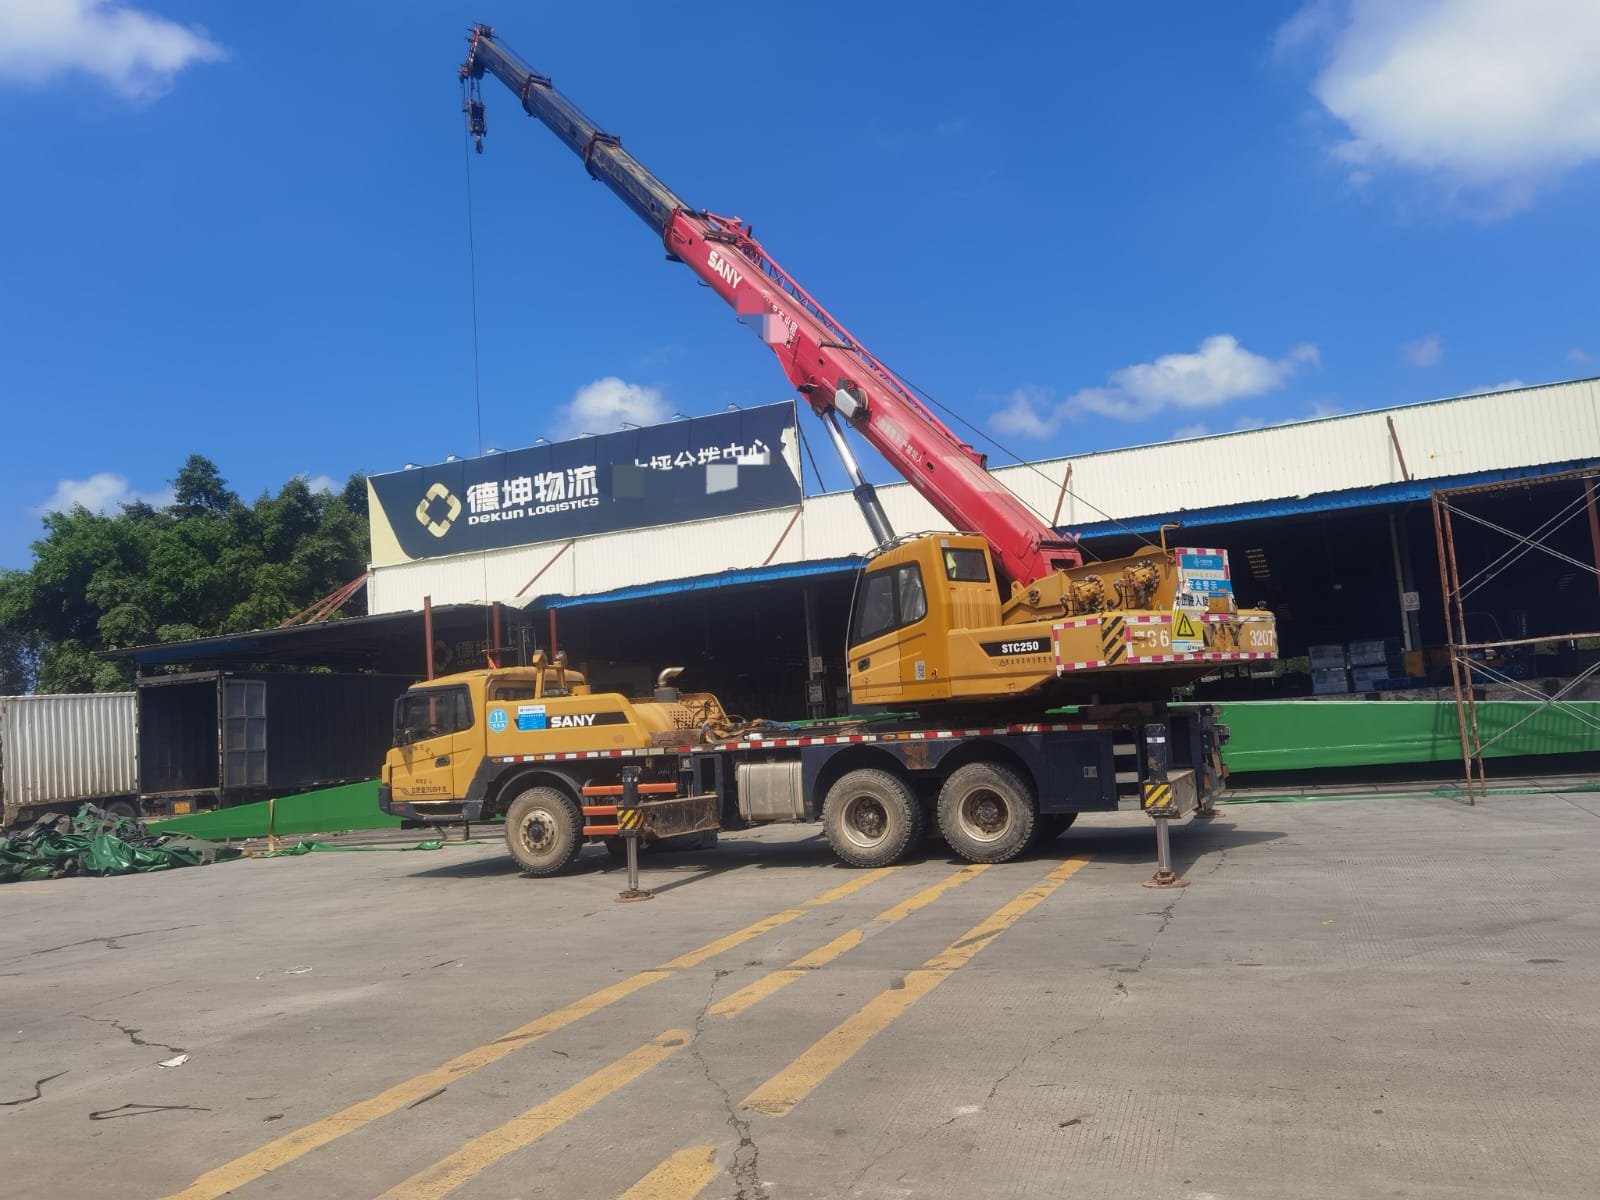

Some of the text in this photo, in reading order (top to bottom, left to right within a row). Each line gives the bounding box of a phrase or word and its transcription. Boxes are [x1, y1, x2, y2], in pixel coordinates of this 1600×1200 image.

[707, 250, 743, 289] SANY
[466, 465, 599, 514] 德坤物流
[528, 497, 600, 517] LOGISTICS
[1001, 641, 1039, 654] STC250
[1250, 630, 1273, 647] 3207
[550, 713, 596, 729] SANY
